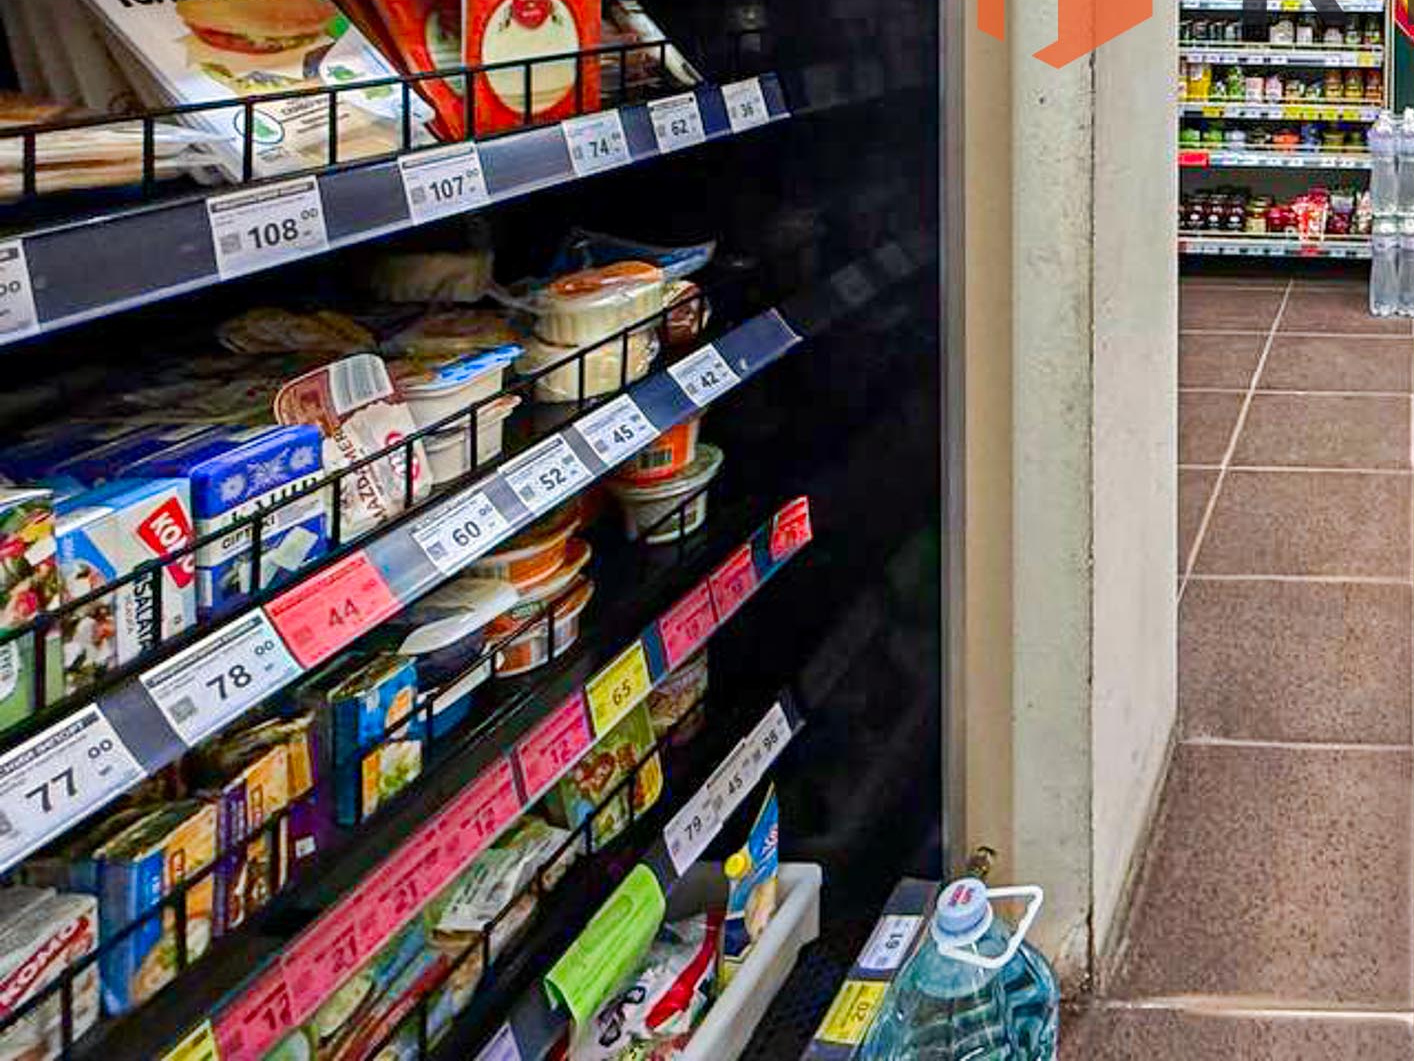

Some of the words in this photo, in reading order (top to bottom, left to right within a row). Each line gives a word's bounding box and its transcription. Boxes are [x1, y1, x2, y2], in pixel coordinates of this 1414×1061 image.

[428, 176, 465, 202] 107
[248, 218, 299, 249] 108
[699, 370, 720, 390] 42
[612, 426, 635, 444] 45
[538, 468, 568, 492] 52
[452, 521, 482, 548] 60
[327, 597, 360, 630] 44
[206, 664, 254, 702] 78
[611, 681, 632, 706] 65
[25, 766, 81, 815] 77
